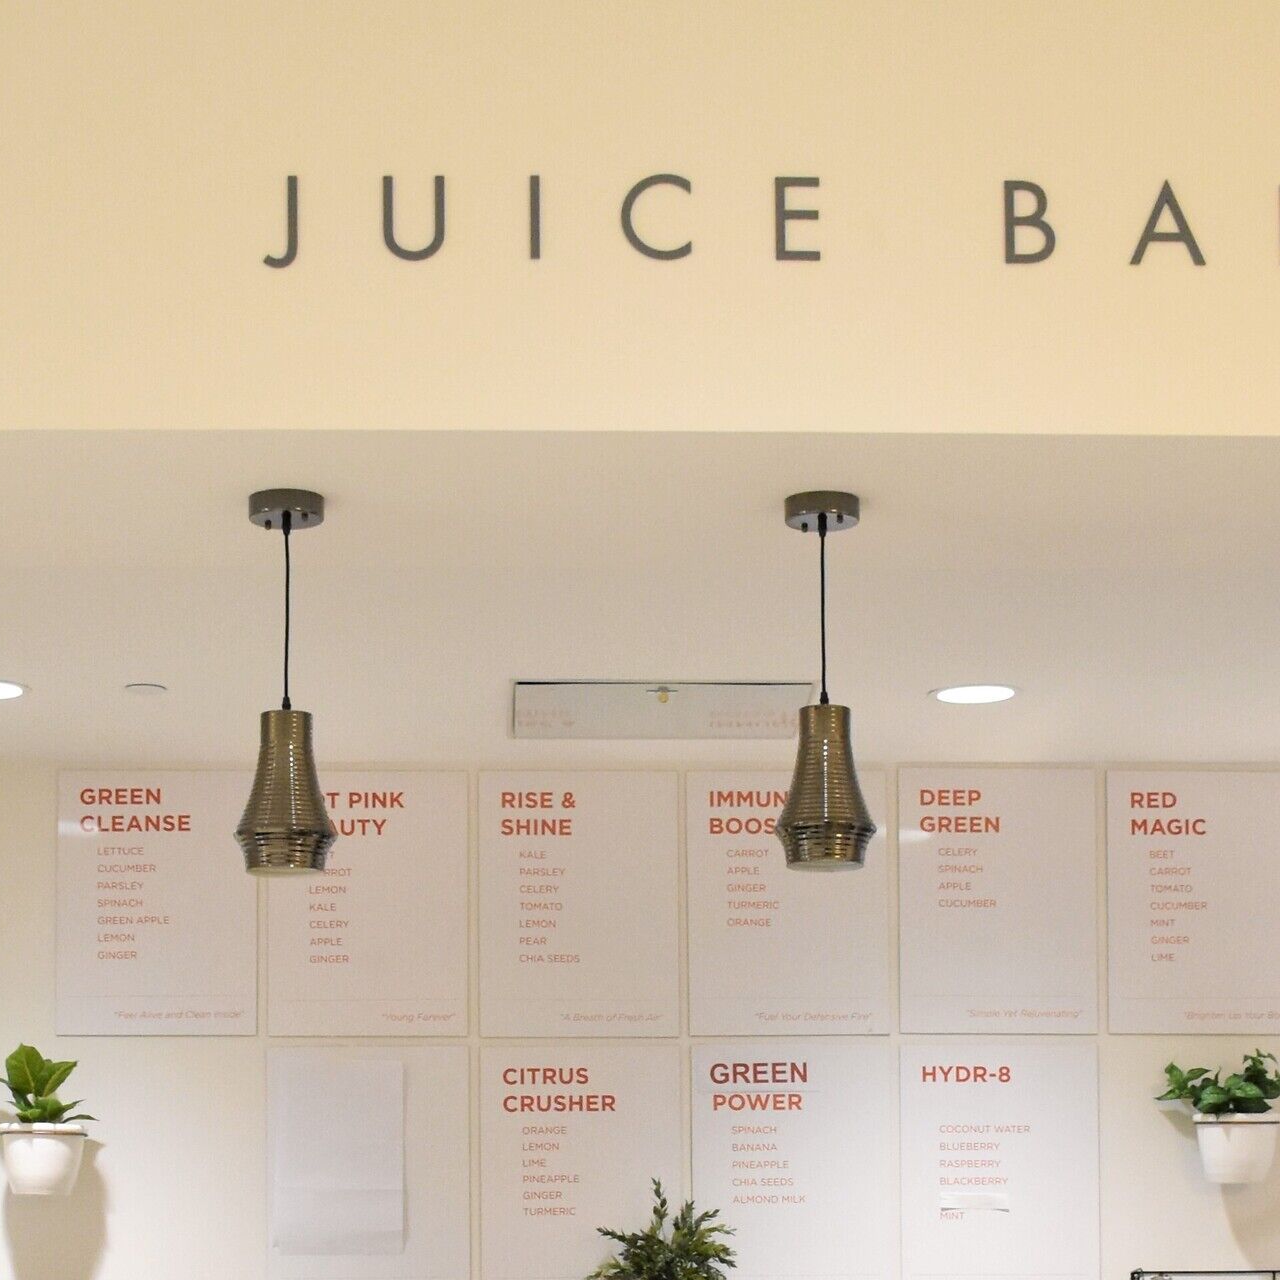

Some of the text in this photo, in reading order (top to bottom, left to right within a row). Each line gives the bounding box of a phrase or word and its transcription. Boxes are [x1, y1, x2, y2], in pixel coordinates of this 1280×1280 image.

[262, 173, 821, 269] JUICE
[80, 788, 161, 805] GREEN
[349, 792, 404, 809] PINK
[501, 792, 576, 809] RISE &
[709, 790, 788, 809] IMMUN
[920, 789, 981, 806] DEEP
[1130, 792, 1177, 808] RED
[80, 815, 191, 832] CLEANSE
[330, 819, 387, 836] AUTY
[501, 818, 572, 836] SHINE
[709, 817, 774, 835] BOOS
[920, 816, 1000, 833] GREEN
[1131, 818, 1206, 836] MAGIC
[97, 846, 144, 856] LETTUCE
[519, 850, 546, 860] KALE
[726, 849, 769, 858] CARROT
[938, 847, 978, 857] CELERY
[1149, 850, 1175, 860] BEET
[97, 864, 156, 873] CUCUMBER
[324, 866, 352, 877] RROT
[519, 868, 566, 877] PARSLEY
[726, 866, 760, 876] APPLE
[938, 864, 984, 874] SPINACH
[1149, 867, 1192, 876] CARROT
[97, 881, 144, 890] PARSLEY
[308, 885, 346, 894] LEMON
[519, 884, 560, 894] CELERY
[726, 883, 766, 893] GINGER
[938, 882, 972, 891] APPLE
[1150, 884, 1193, 894] TOMATO
[97, 898, 143, 908] SPINACH
[309, 902, 336, 912] KALE
[520, 902, 563, 911] TOMATO
[728, 900, 780, 910] TURMERIC
[938, 899, 997, 908] CUCUMBER
[1150, 901, 1208, 911] CUCUMBER
[97, 916, 169, 925] GREEN APPLE
[309, 920, 349, 929] CELERY
[519, 919, 556, 928] LEMON
[726, 918, 771, 927] ORANGE
[1150, 918, 1176, 927] MINT
[97, 933, 135, 943] LEMON
[310, 937, 342, 946] APPLE
[519, 936, 547, 946] PEAR
[1150, 935, 1190, 945] GINGER
[97, 950, 137, 960] GINGER
[309, 954, 349, 964] GINGER
[519, 954, 580, 964] CHIA SEEDS
[1151, 953, 1174, 962] LIME
[502, 1067, 589, 1086] CITRUS
[710, 1062, 808, 1084] GREEN
[922, 1066, 1011, 1083] HYDR-8
[503, 1095, 616, 1113] CRUSHER
[713, 1094, 802, 1111] POWER
[522, 1126, 567, 1135] ORANGE
[731, 1126, 777, 1135] SPINACH
[938, 1124, 1031, 1134] COCONUT WATER
[522, 1142, 560, 1152] LEMON
[732, 1143, 778, 1152] BANANA
[939, 1142, 1000, 1151] BLUEBERRY
[522, 1158, 546, 1168] LIME
[732, 1160, 789, 1169] PINEAPPLE
[939, 1159, 1001, 1168] RASPBERRY
[522, 1174, 580, 1184] PINEAPPLE
[732, 1177, 794, 1187] CHIA SEEDS
[939, 1176, 1008, 1186] BLACKBERRY
[522, 1190, 562, 1200] GINGER
[732, 1195, 805, 1204] ALMOND MILK
[523, 1207, 576, 1216] TURMERIC
[940, 1210, 965, 1220] MINT
